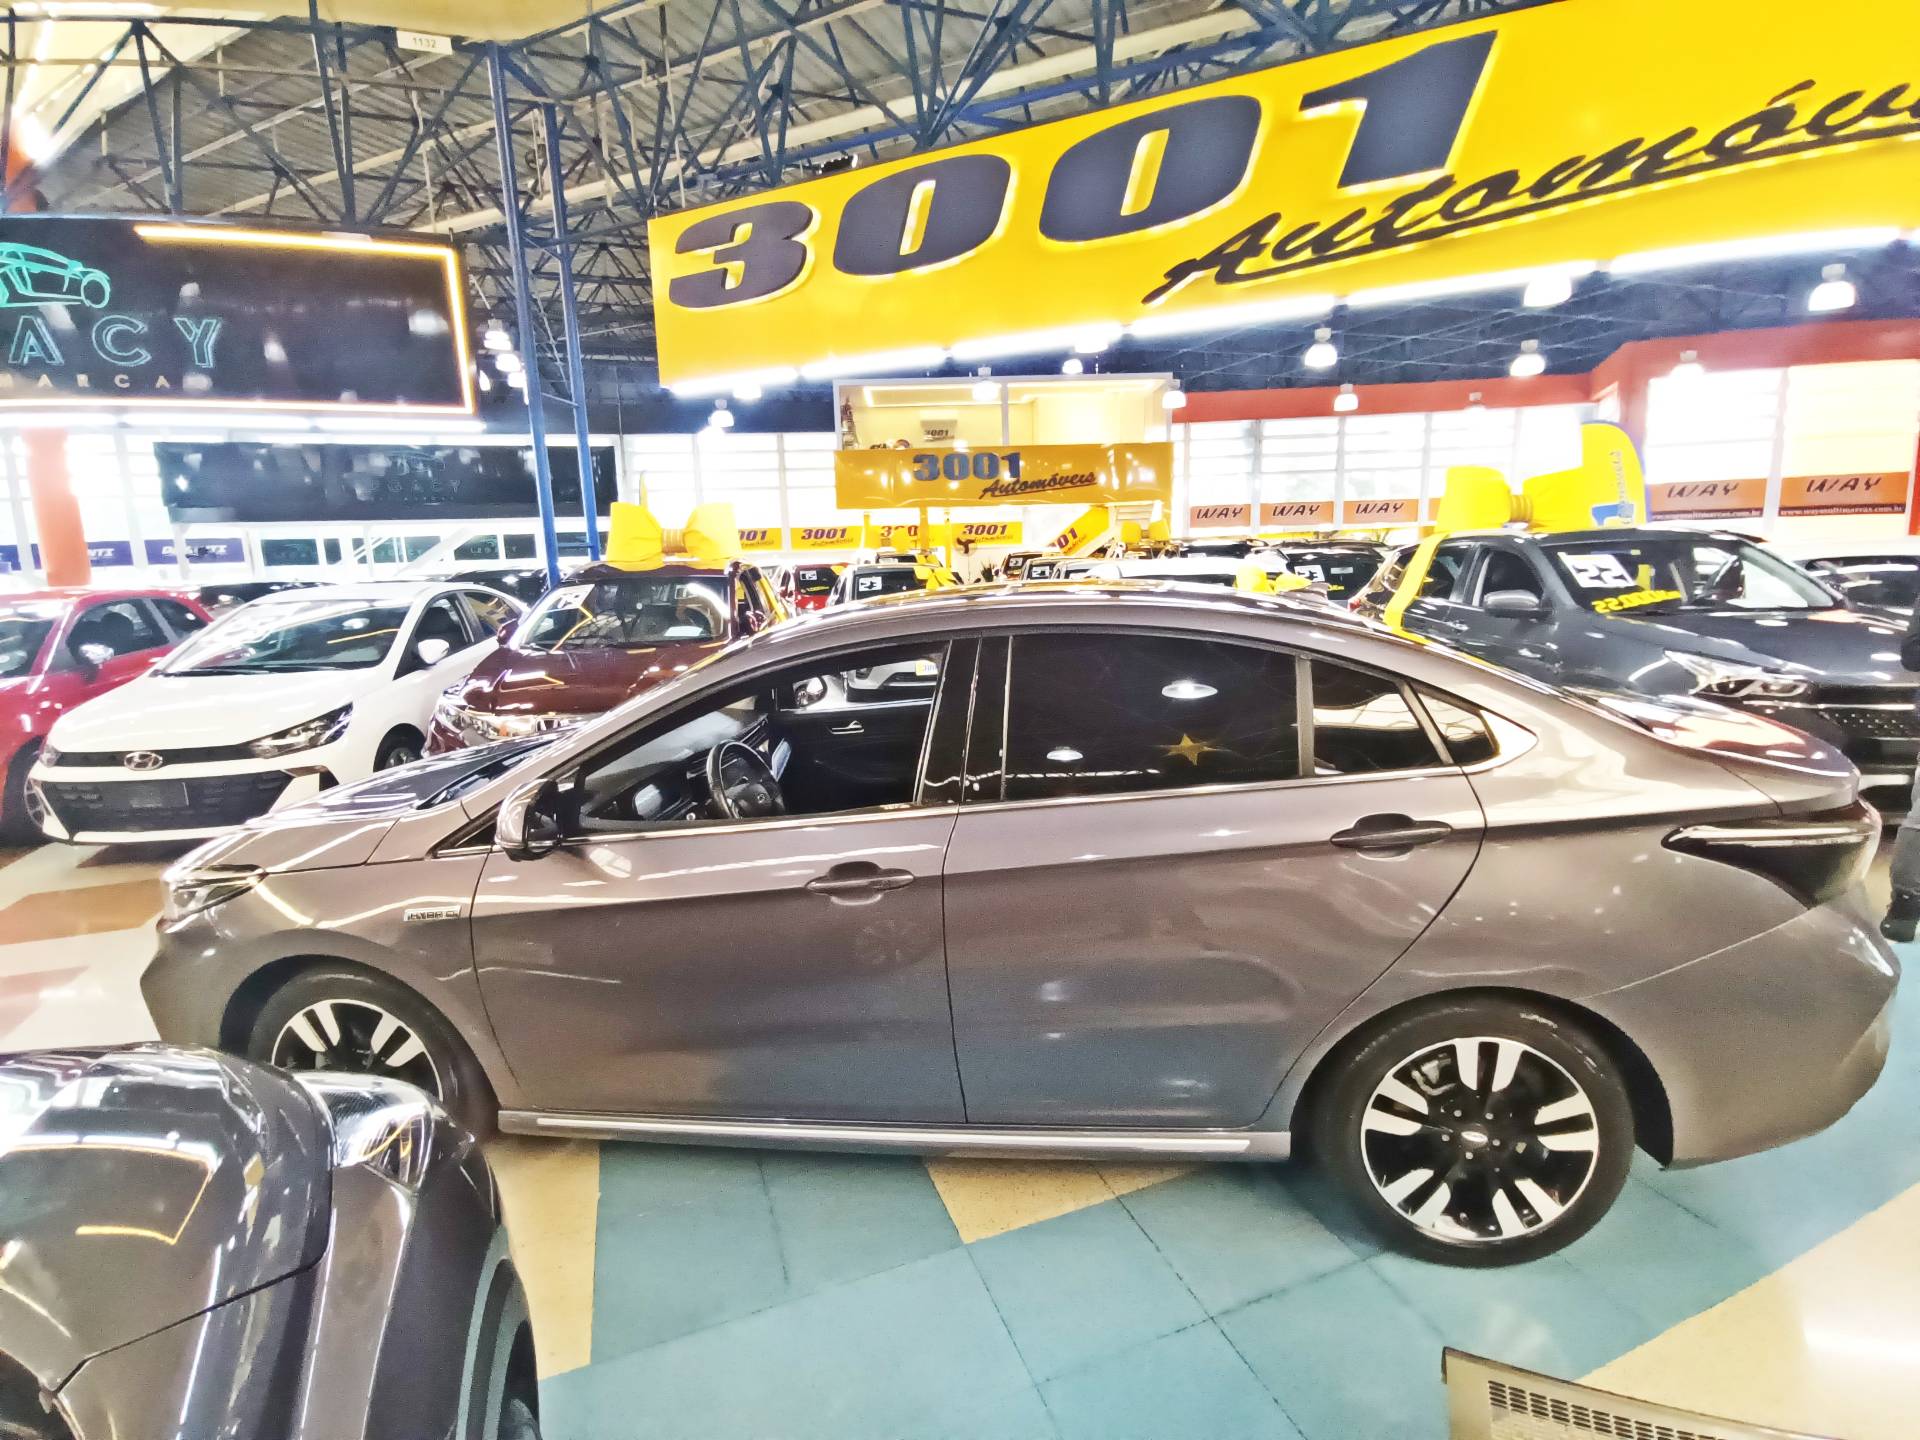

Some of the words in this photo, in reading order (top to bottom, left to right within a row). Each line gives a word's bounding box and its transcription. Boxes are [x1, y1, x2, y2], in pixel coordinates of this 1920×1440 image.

[667, 30, 1497, 308] 3001
[1141, 80, 1920, 304] Automóv
[913, 452, 1021, 481] 3001
[979, 471, 1097, 499] Automóveis
[1667, 483, 1740, 498] WAY
[1806, 477, 1882, 492] WAY
[1196, 508, 1244, 519] WAY
[1273, 504, 1320, 516] WAY
[1356, 502, 1404, 514] WAY
[801, 528, 847, 540] 3001
[962, 524, 1008, 536] 3001
